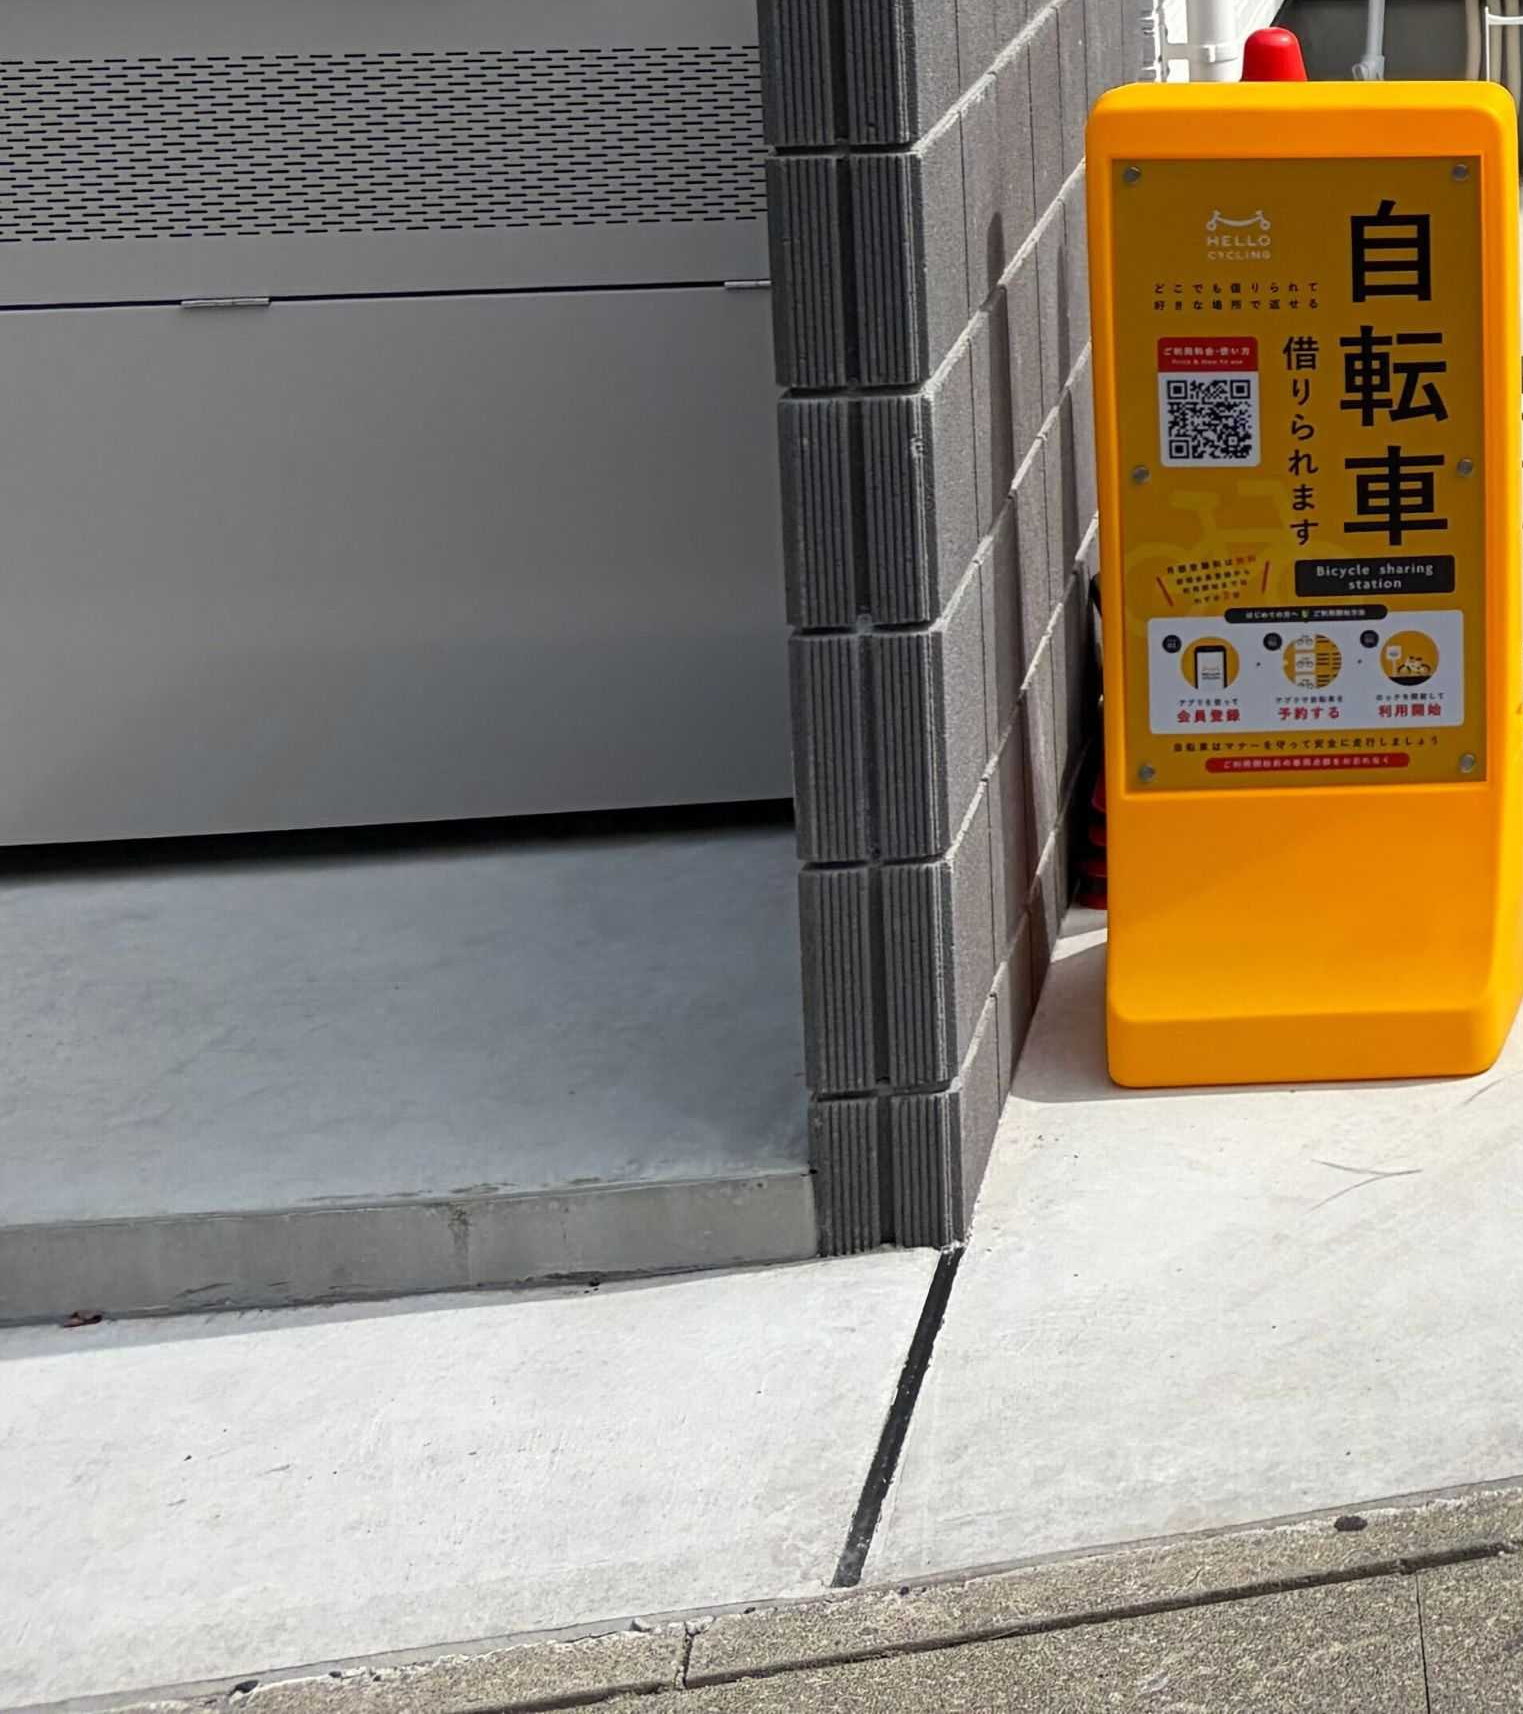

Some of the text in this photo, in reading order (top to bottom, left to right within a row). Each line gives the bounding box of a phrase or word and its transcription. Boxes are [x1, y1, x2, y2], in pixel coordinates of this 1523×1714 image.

[1207, 235, 1271, 247] HELLO
[1208, 250, 1271, 261] CYCLING
[1339, 199, 1449, 547] 自転車
[1283, 336, 1319, 547] 借りられます
[1316, 562, 1434, 579] Bicycle sharing
[1348, 577, 1402, 590] station
[1177, 708, 1240, 723] 会員登録
[1278, 705, 1340, 721] 予約する
[1378, 703, 1441, 718] 利用開始
